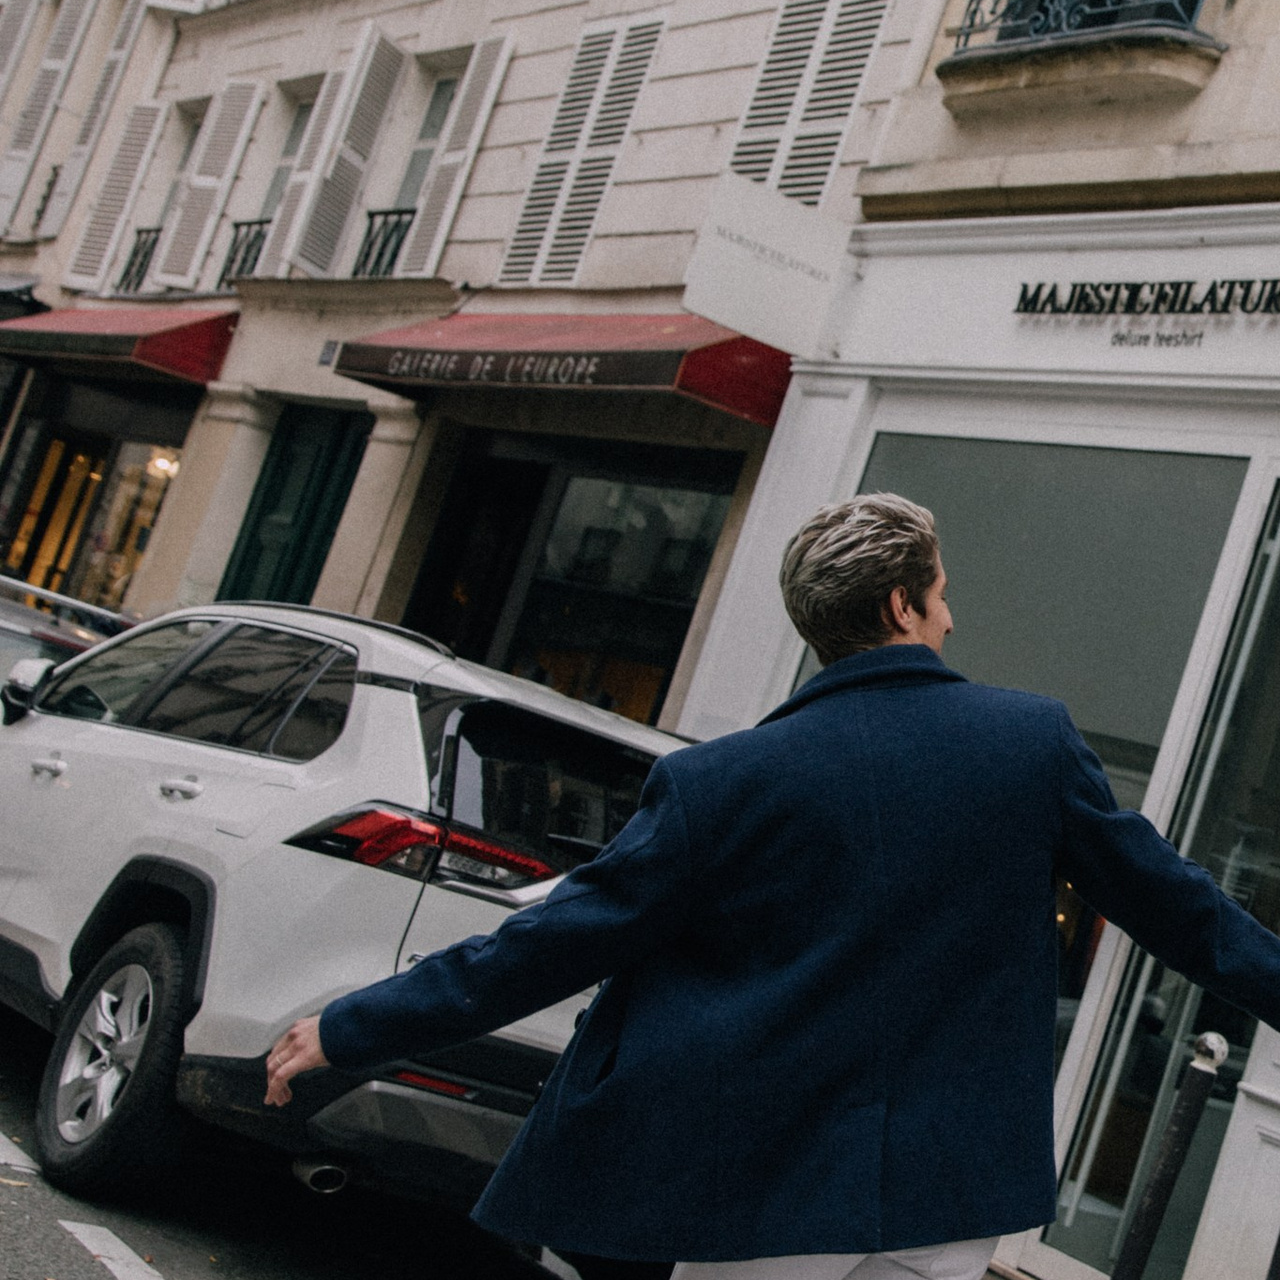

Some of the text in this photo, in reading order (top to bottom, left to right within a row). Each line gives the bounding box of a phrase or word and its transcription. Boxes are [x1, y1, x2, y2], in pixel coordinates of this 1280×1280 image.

[1110, 330, 1150, 348] deluxe
[468, 355, 496, 381] DE
[504, 355, 600, 385] L'EUROPE
